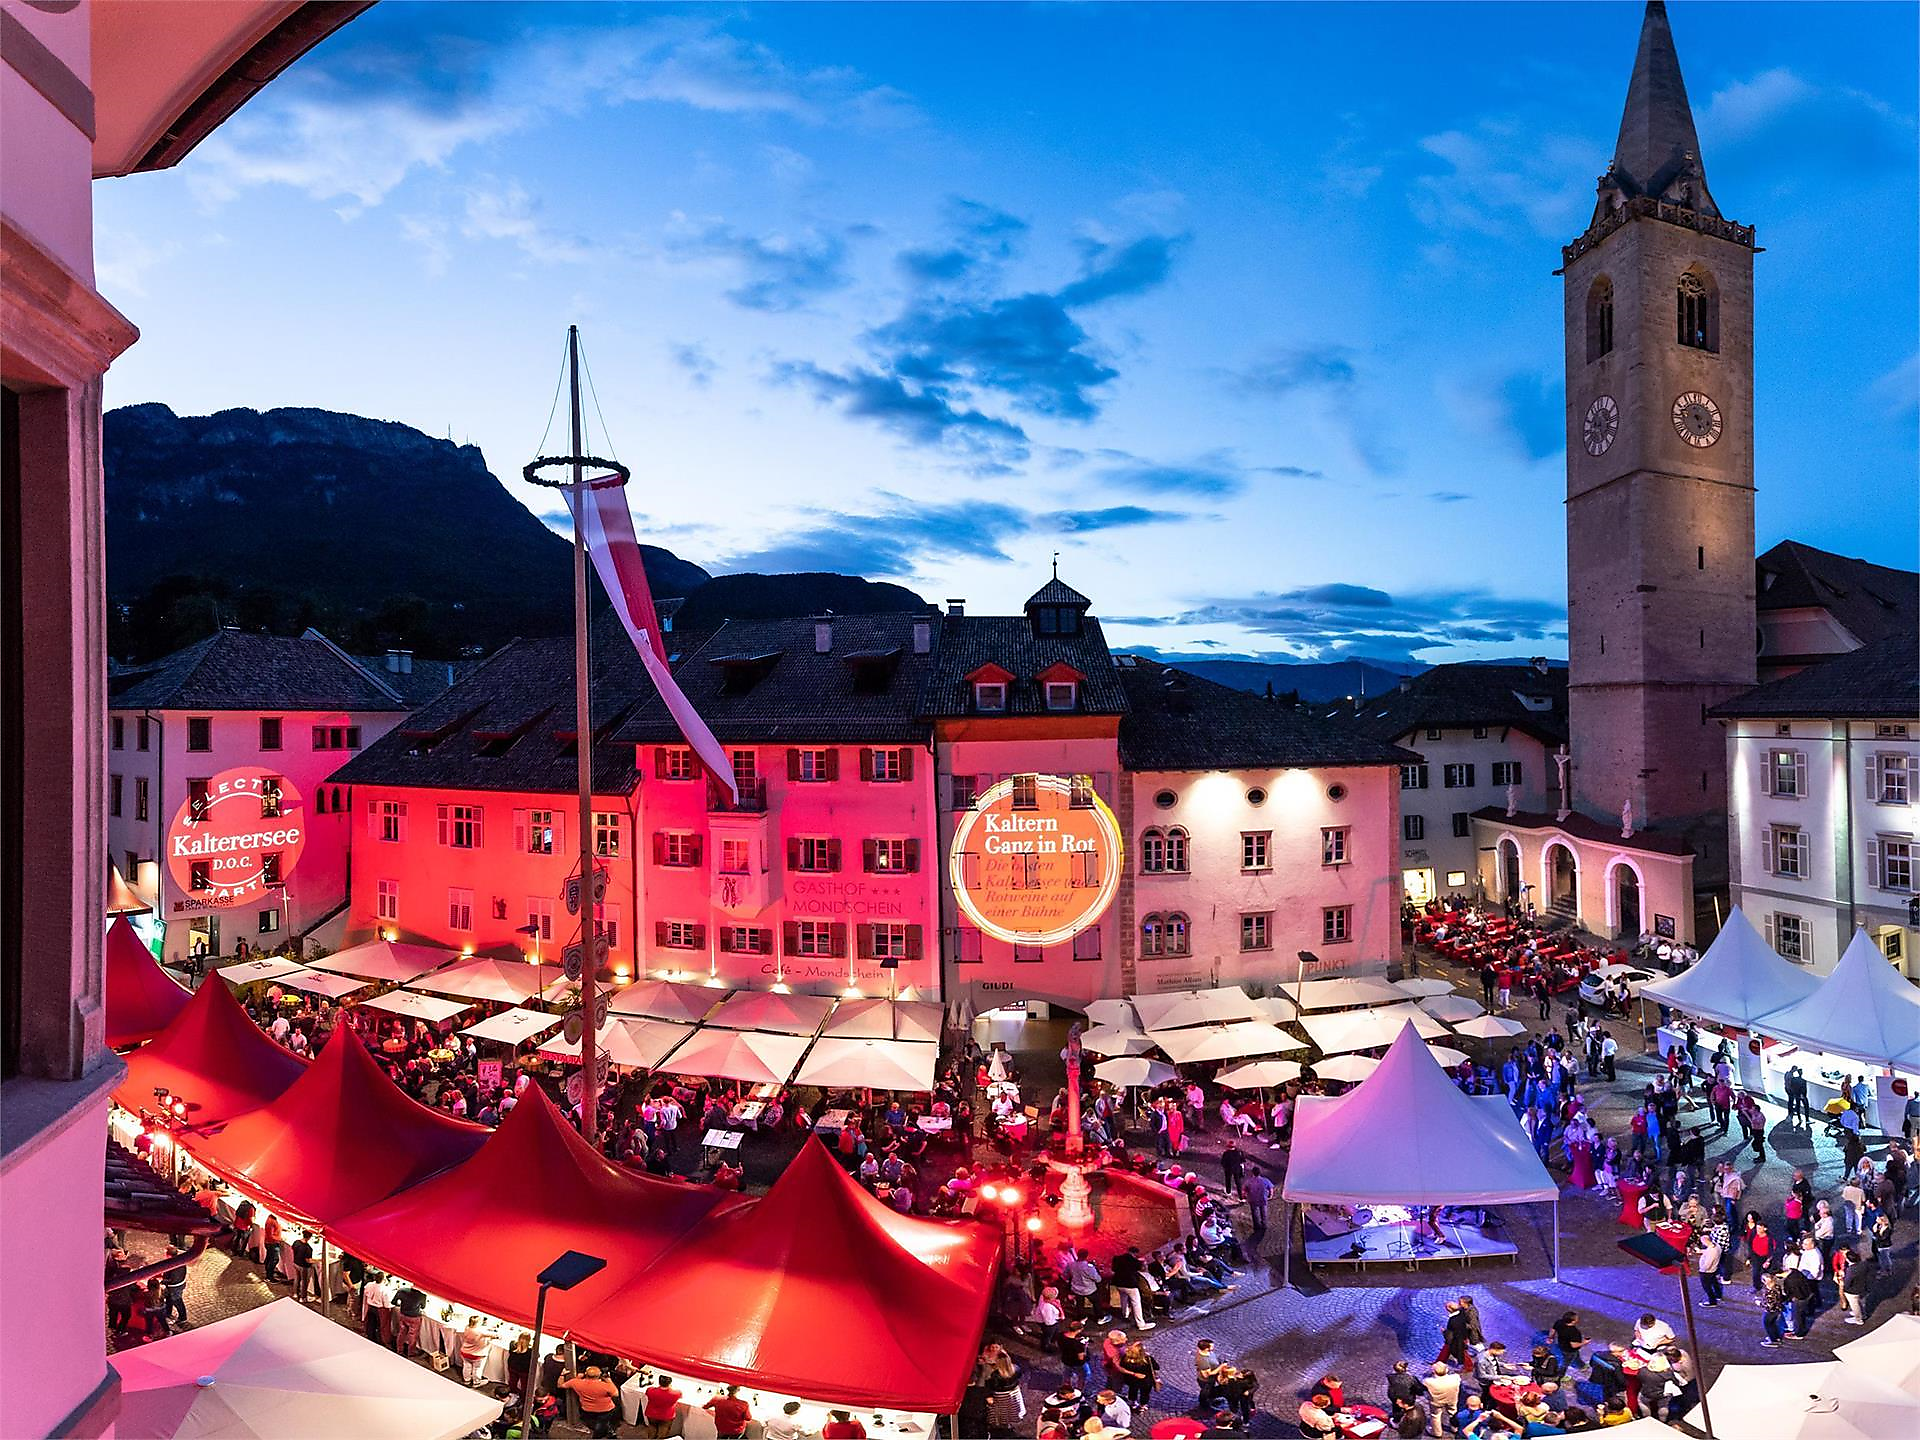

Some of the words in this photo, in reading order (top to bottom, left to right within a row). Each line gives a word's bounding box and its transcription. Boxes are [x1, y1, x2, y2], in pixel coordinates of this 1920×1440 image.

[985, 813, 1058, 832] Kaltern
[173, 828, 299, 856] Kalterersee
[985, 835, 1033, 853] Ganz
[1037, 834, 1056, 852] in
[1061, 834, 1096, 852] Rot
[213, 856, 252, 870] D.O.C.
[985, 859, 1008, 871] Die
[793, 880, 866, 896] GASTHOF
[185, 896, 234, 907] SPARKASSE
[985, 891, 1047, 902] Rotweine
[1051, 892, 1073, 904] auf
[793, 899, 902, 914] MONDSCHEIN
[985, 907, 1019, 916] einer
[761, 964, 792, 976] Café
[1307, 960, 1345, 973] PUNKT
[982, 982, 1014, 990] GIUDI
[540, 1050, 583, 1065] RESTAURA
